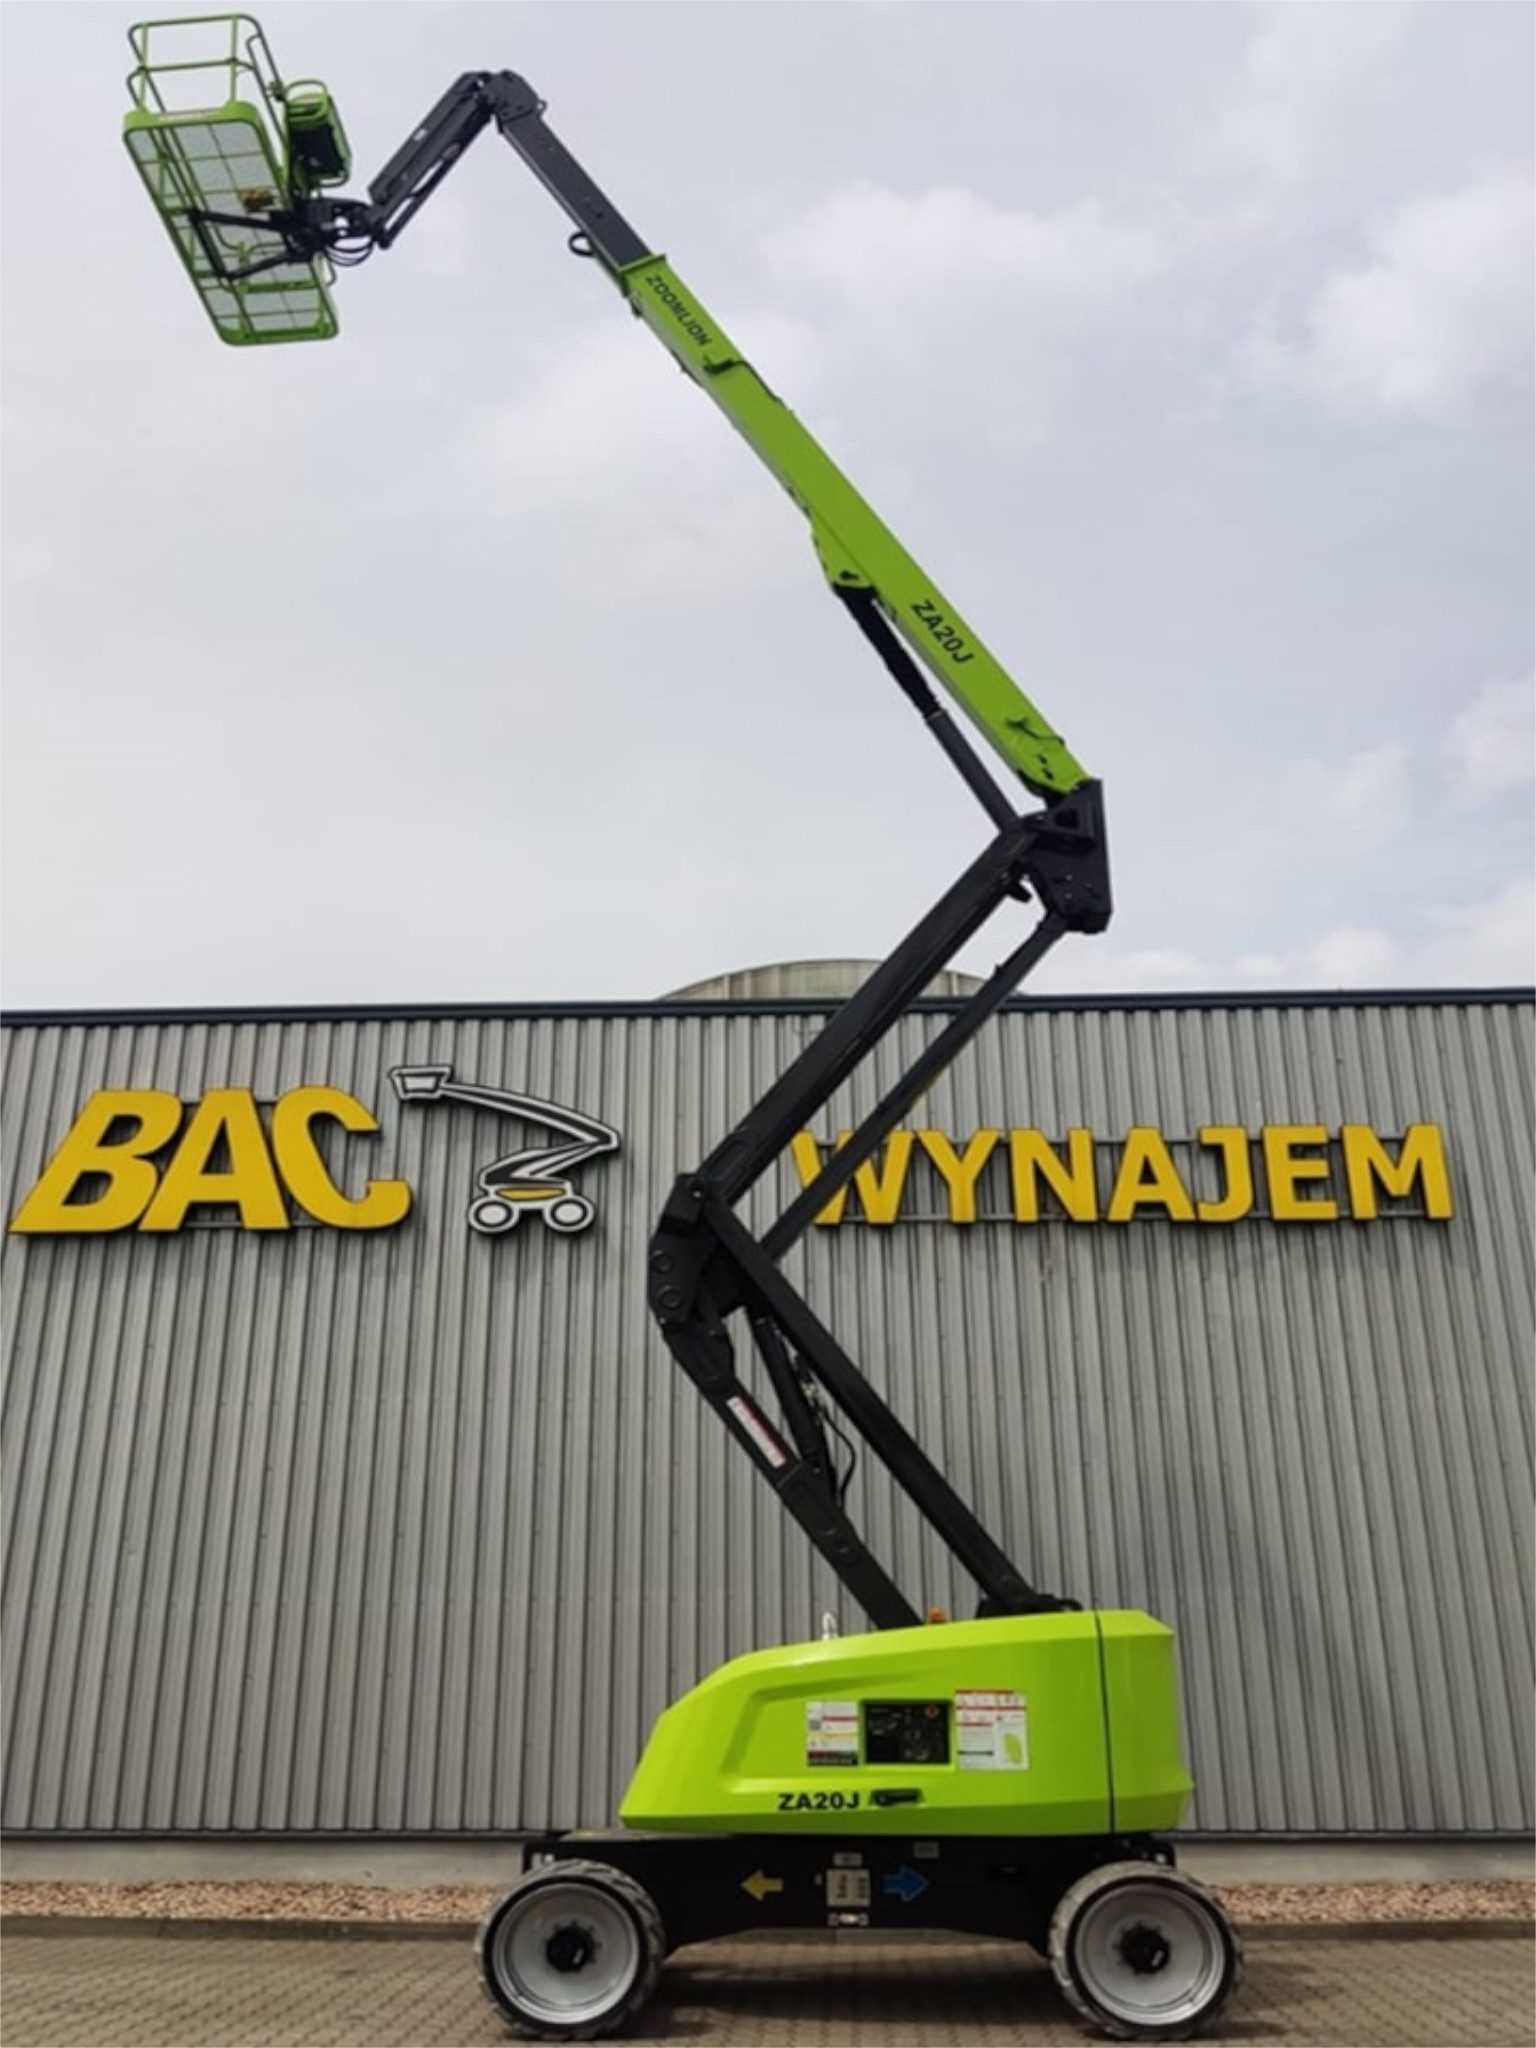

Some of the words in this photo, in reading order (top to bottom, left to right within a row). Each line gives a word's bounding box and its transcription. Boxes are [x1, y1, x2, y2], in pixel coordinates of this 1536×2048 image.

[646, 273, 712, 346] ZOOMLION
[911, 598, 974, 663] ZA20J
[9, 1086, 411, 1234] BAC
[791, 1124, 1452, 1225] WYNAJEM
[778, 1791, 860, 1810] ZA20J
